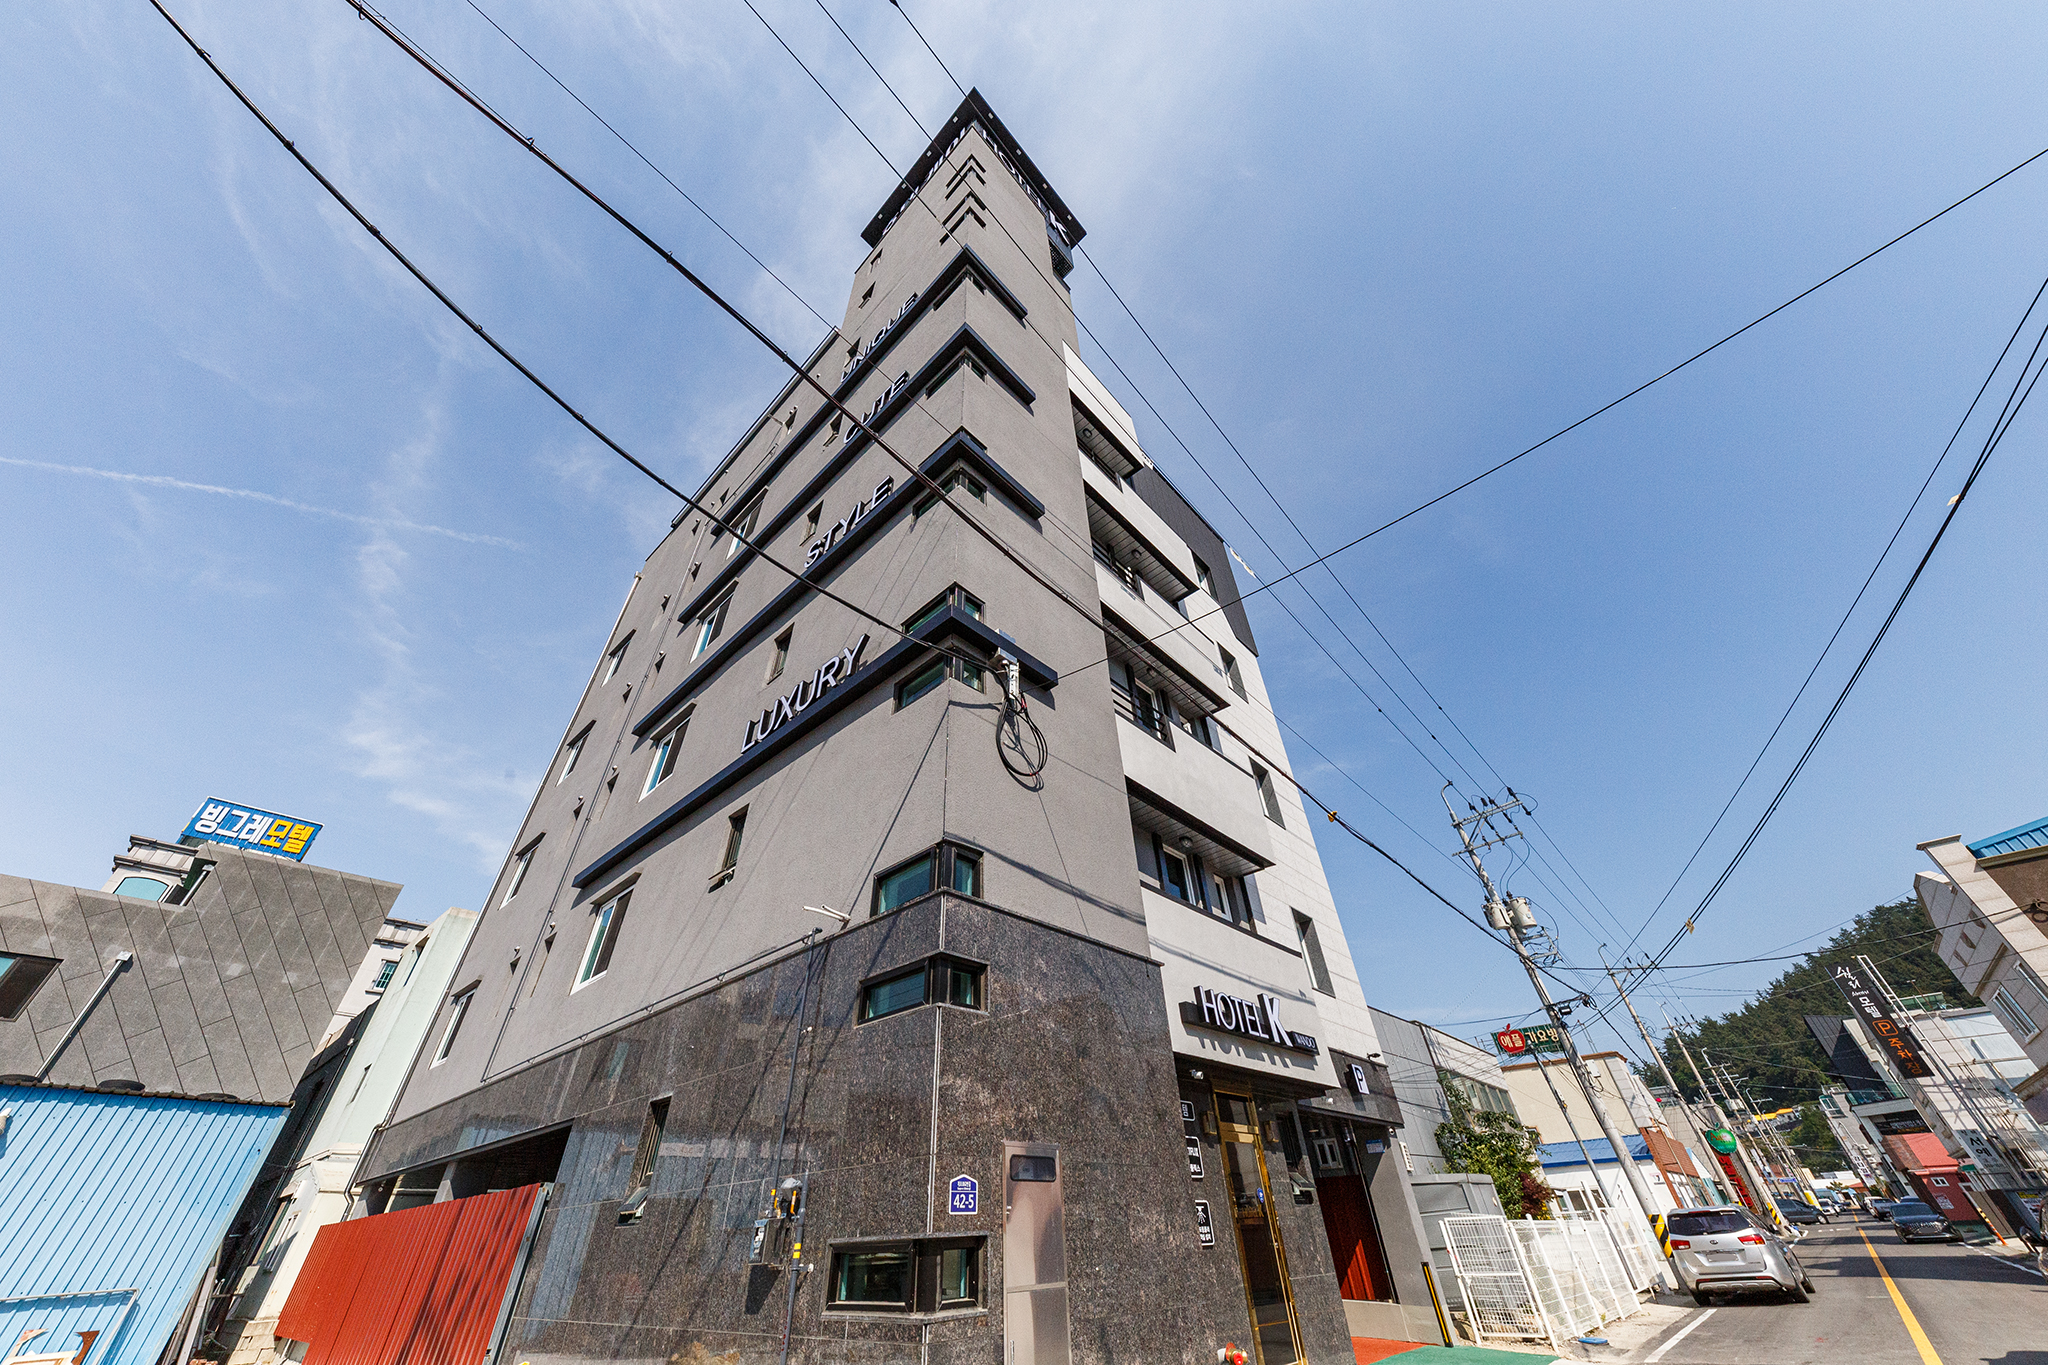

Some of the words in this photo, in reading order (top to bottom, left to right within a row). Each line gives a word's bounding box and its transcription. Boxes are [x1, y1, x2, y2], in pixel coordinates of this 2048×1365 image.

[841, 294, 917, 383] UNIQUE
[843, 370, 909, 443] CUTE
[804, 475, 892, 568] STYLE
[741, 633, 867, 754] LUXURY
[195, 803, 274, 844] 빙그레
[260, 819, 315, 854] 모텔
[1198, 985, 1269, 1039] HOTEL
[1261, 993, 1293, 1048] K
[1293, 1032, 1316, 1048] WANDO
[1859, 996, 1882, 1018] 모텔
[1500, 1033, 1524, 1048] 애플
[1525, 1027, 1560, 1044] 가요방
[1888, 1038, 1923, 1074] 주차장
[953, 1194, 975, 1209] 42-5
